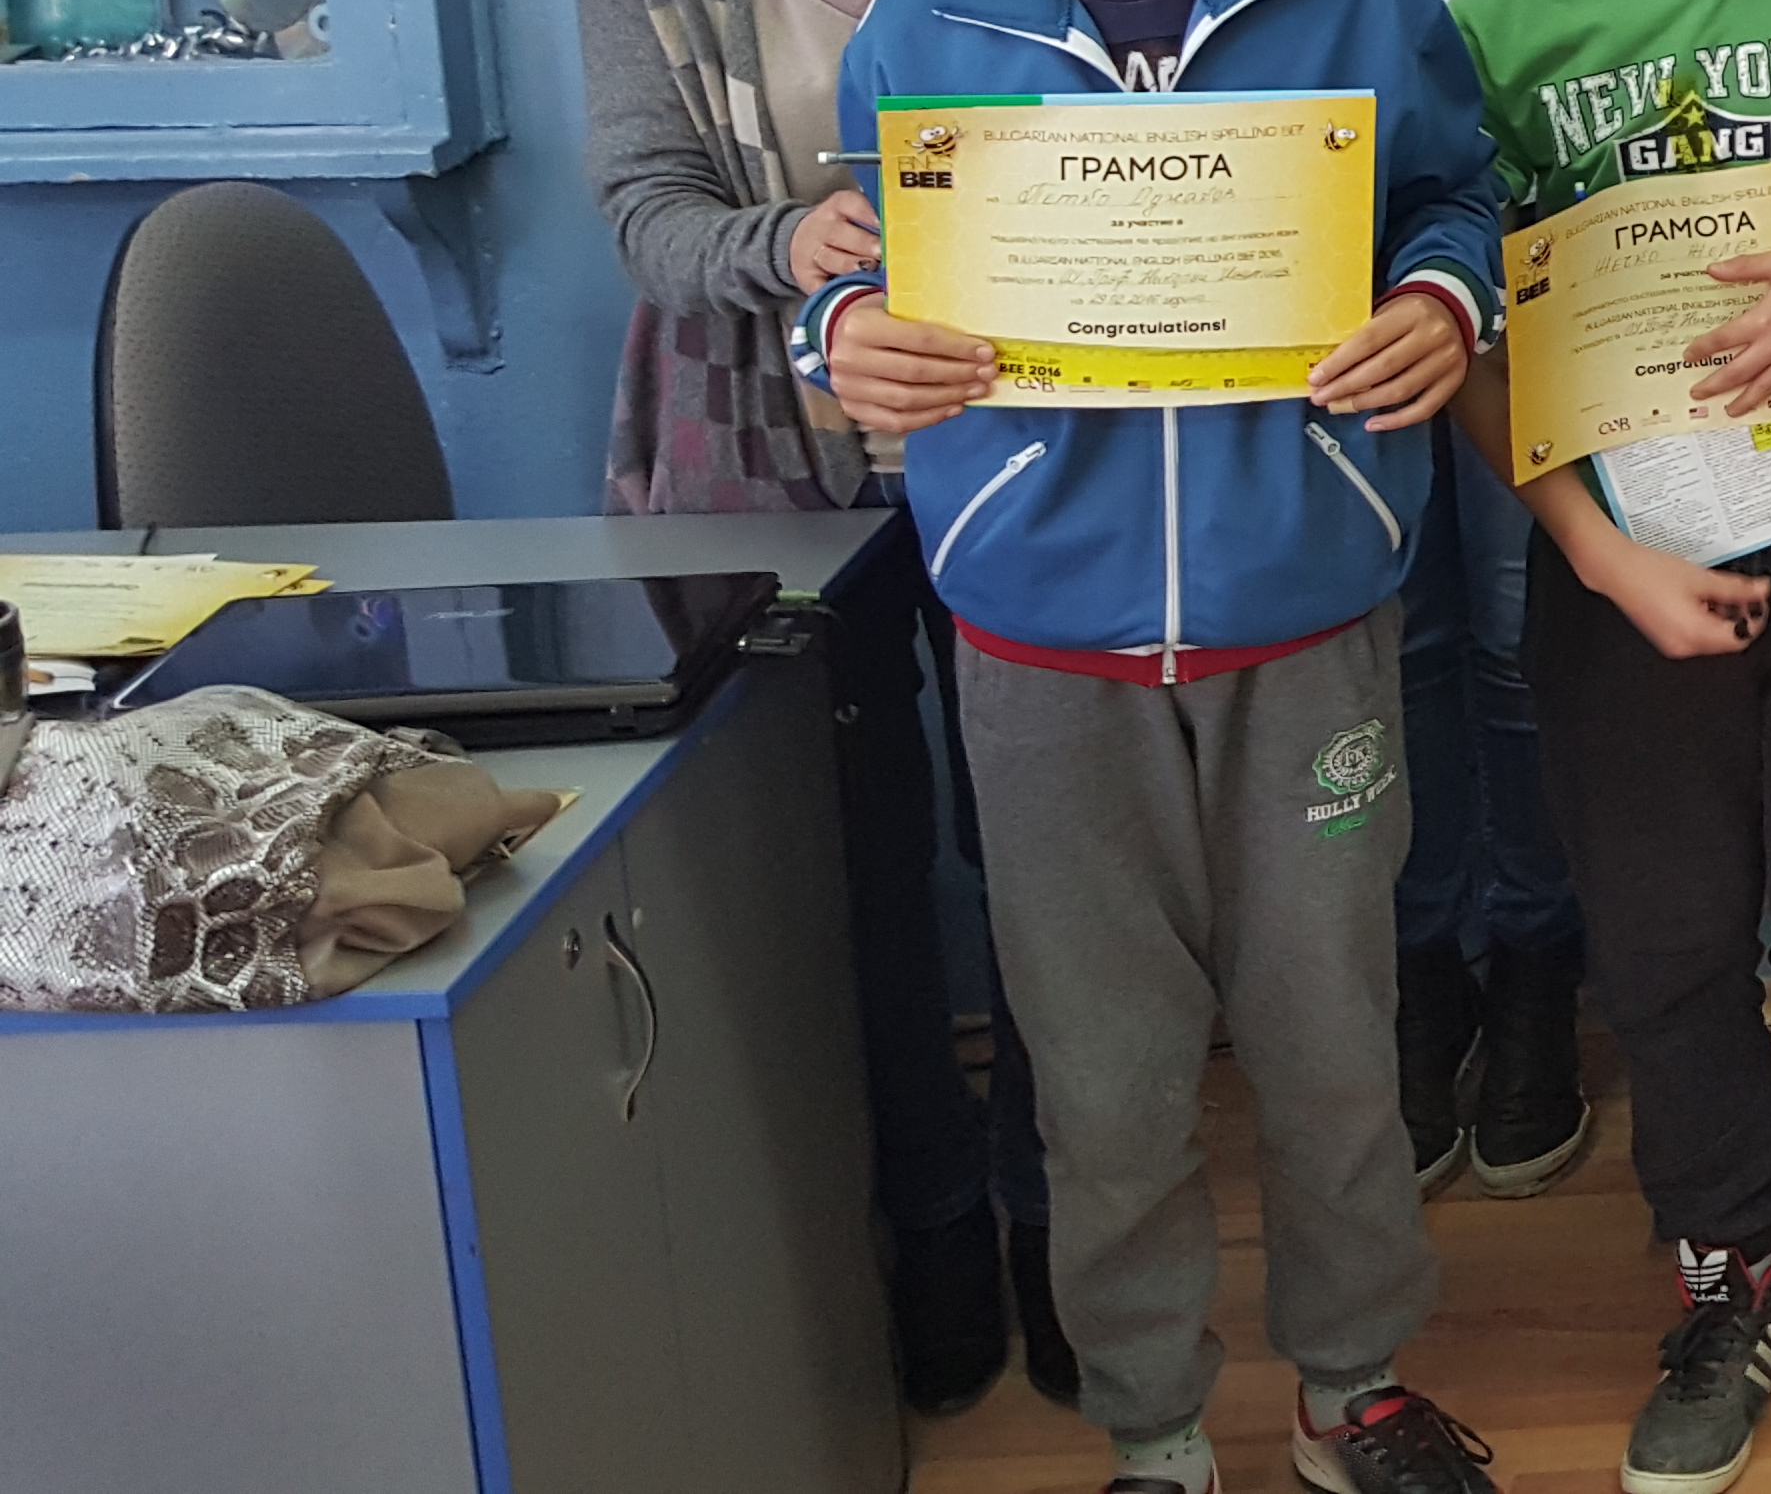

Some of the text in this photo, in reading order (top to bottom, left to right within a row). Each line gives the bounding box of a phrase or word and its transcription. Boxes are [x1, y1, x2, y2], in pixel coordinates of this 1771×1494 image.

[1537, 54, 1677, 168] NEW
[1628, 127, 1765, 173] GANG
[900, 171, 953, 188] BEE
[1061, 154, 1232, 181] ГРАМОТА
[1614, 210, 1756, 250] ГРАМОТА
[1516, 277, 1550, 304] BEE
[1068, 319, 1226, 338] Congratulations!
[1029, 366, 1061, 377] 2016
